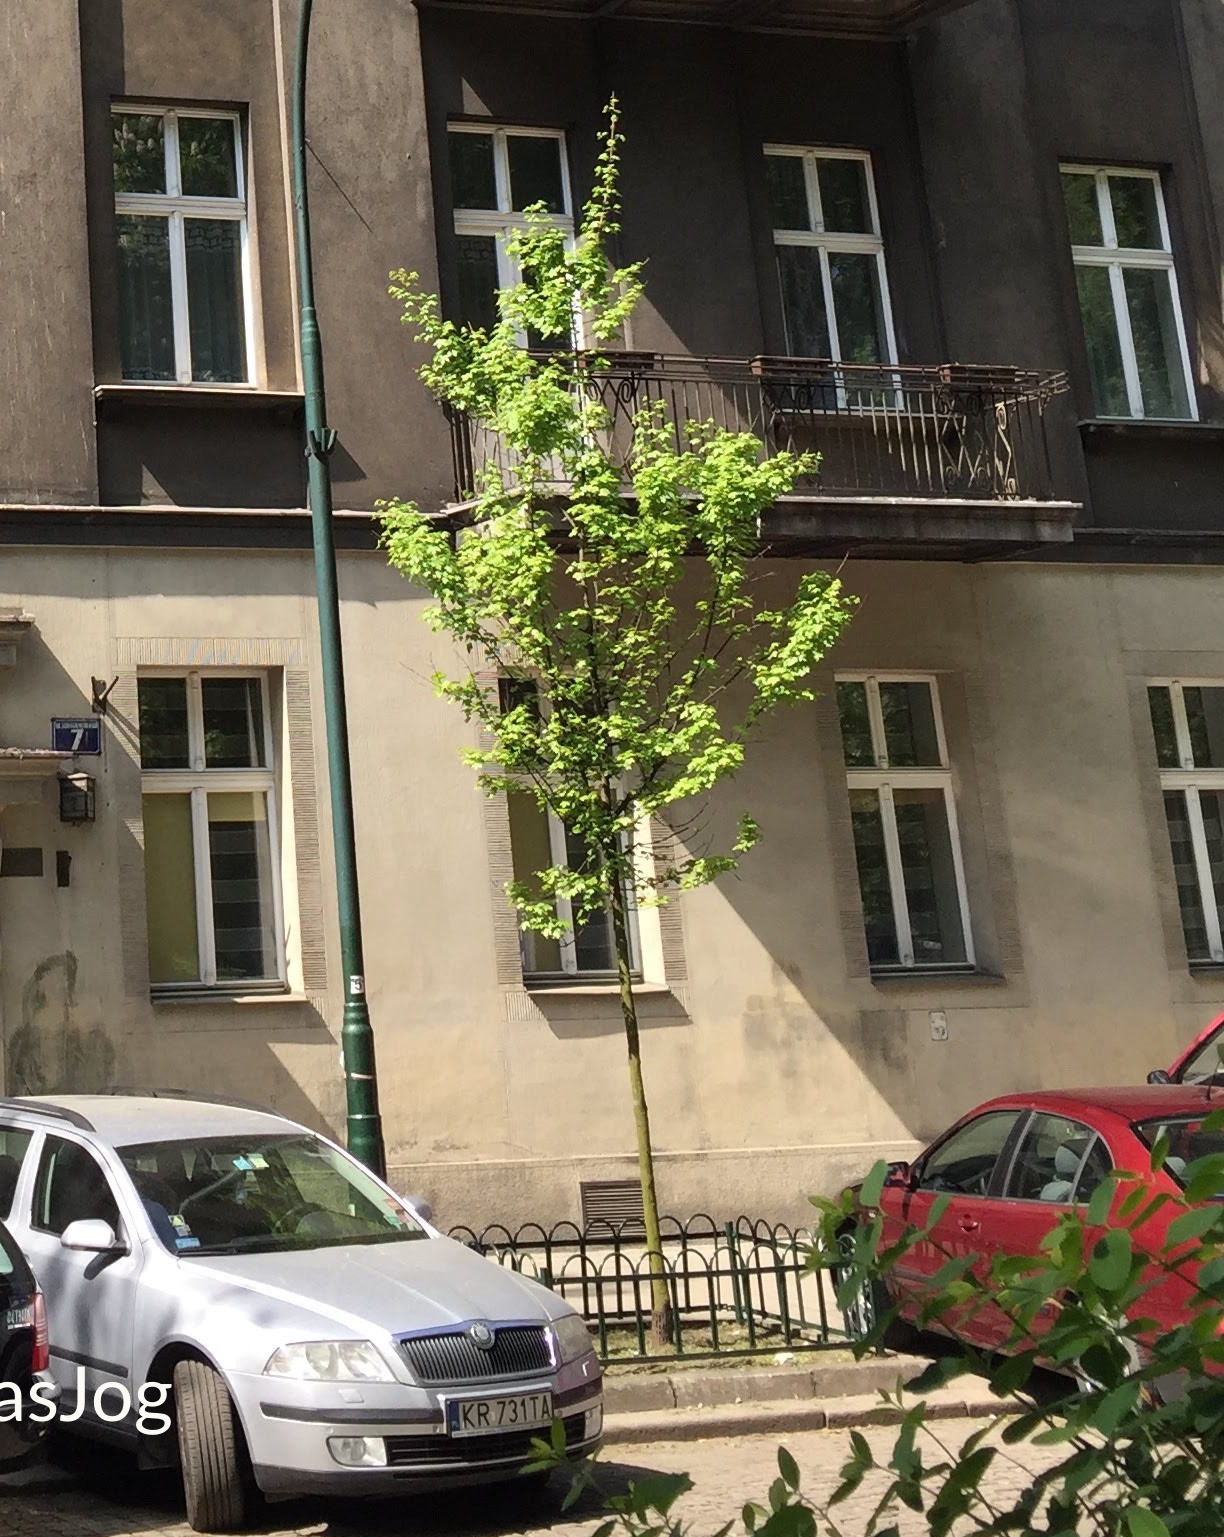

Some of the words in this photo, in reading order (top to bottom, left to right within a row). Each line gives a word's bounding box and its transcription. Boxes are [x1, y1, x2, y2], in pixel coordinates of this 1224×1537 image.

[70, 728, 85, 751] 7
[462, 1402, 490, 1429] KR
[496, 1395, 551, 1425] 731TA
